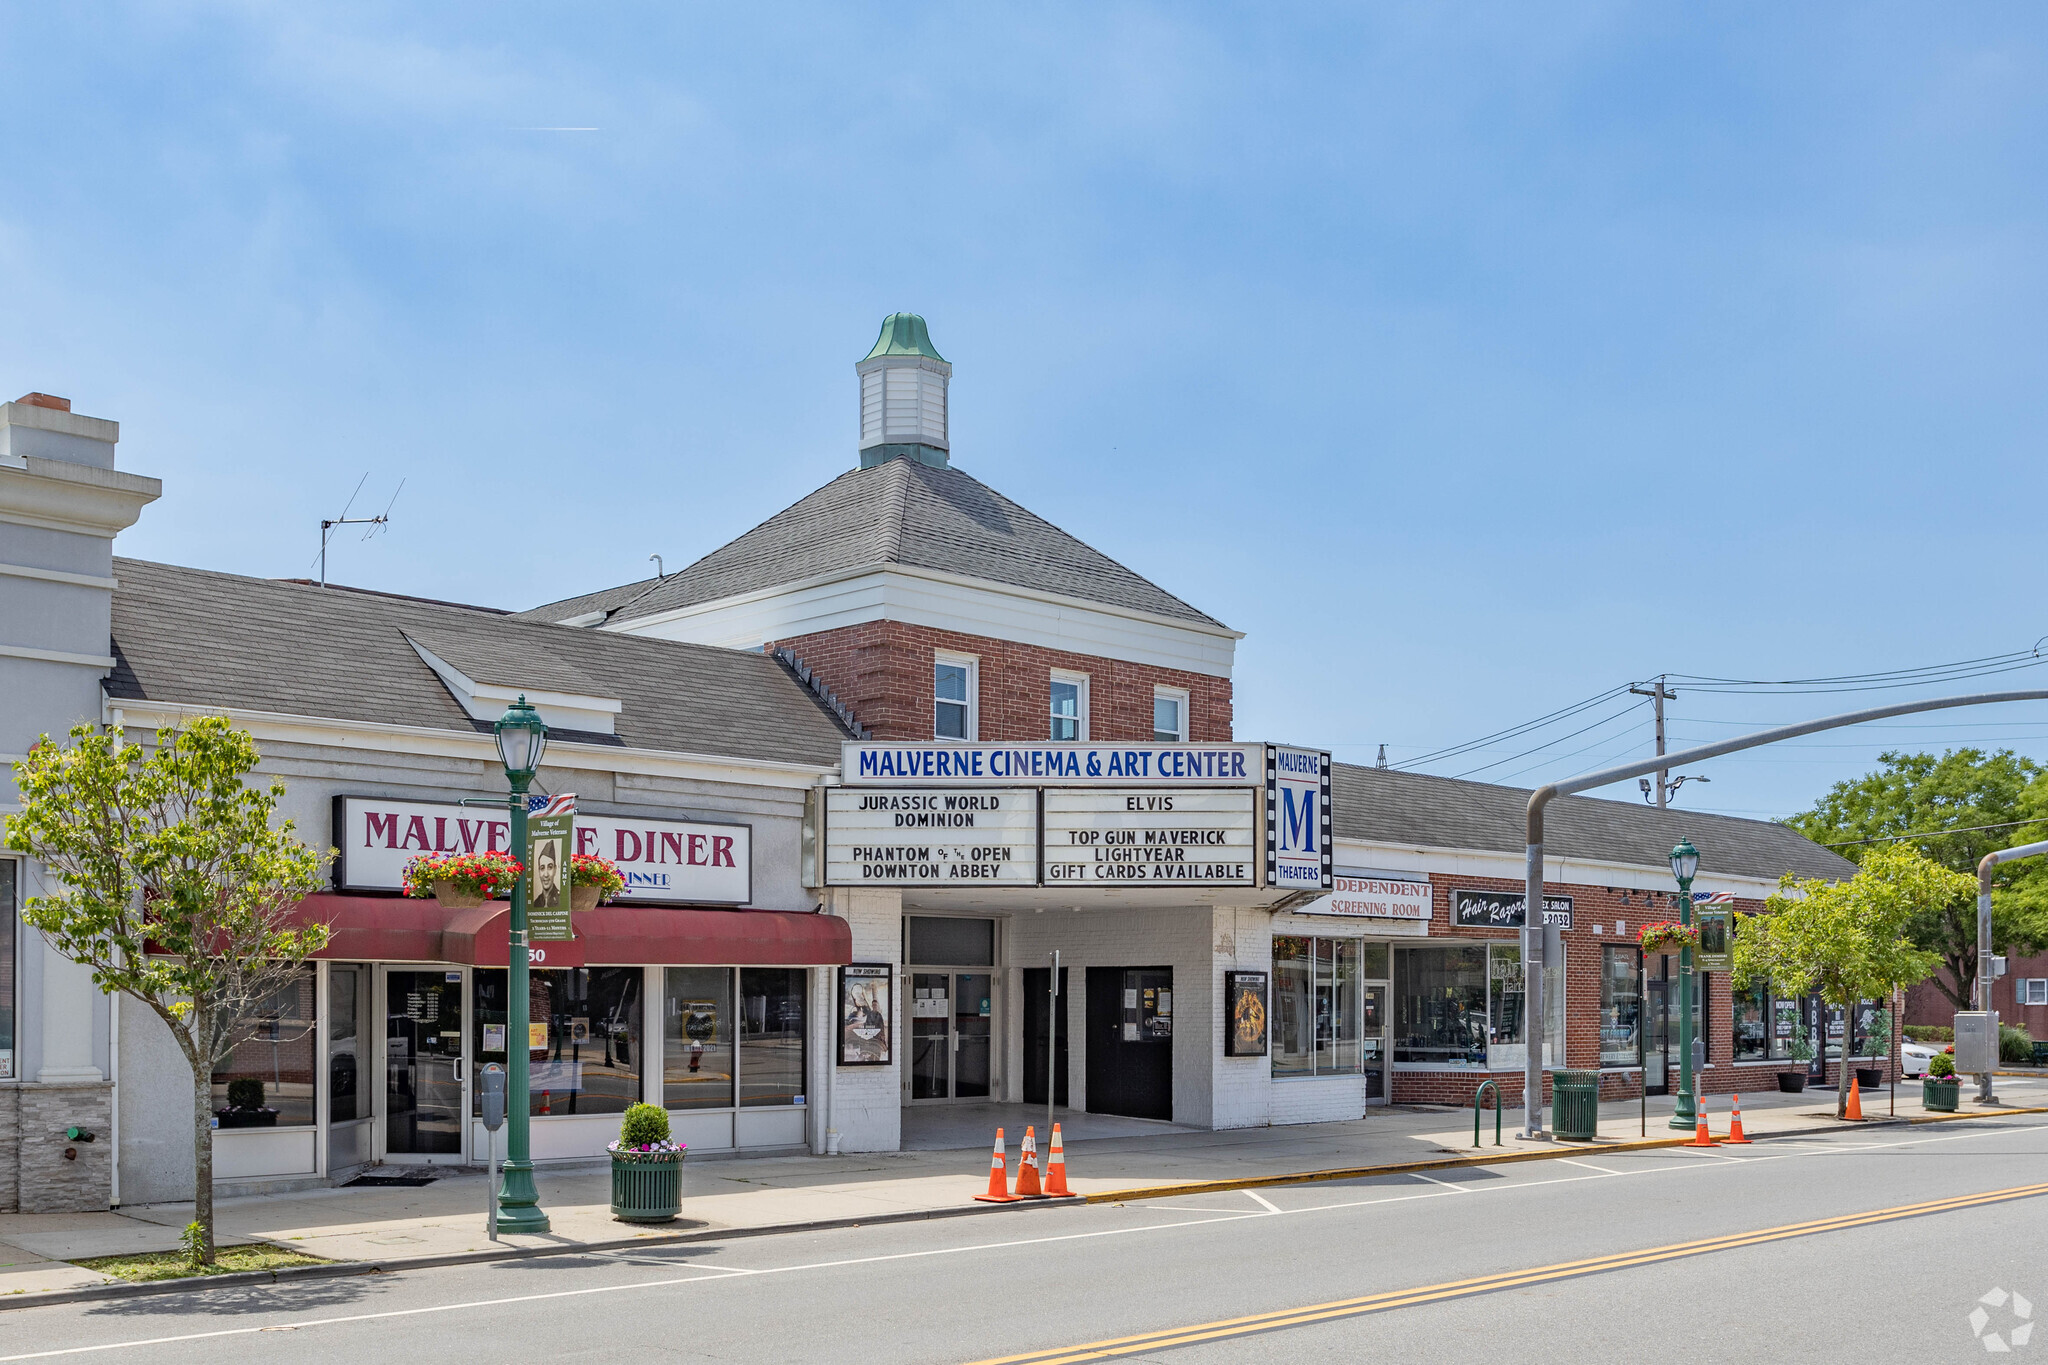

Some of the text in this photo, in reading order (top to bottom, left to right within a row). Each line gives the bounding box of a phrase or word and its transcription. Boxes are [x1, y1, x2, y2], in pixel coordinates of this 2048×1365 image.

[860, 751, 1247, 777] MALVERNE CINEMA & ART CENTER
[1278, 752, 1318, 774] MALVERNE
[859, 796, 1000, 810] JURASSIC WORLD
[1126, 797, 1173, 810] ELVIS
[895, 813, 974, 827] DOMINION
[1279, 786, 1317, 852] M
[1069, 831, 1225, 844] TOP GUN MAVERICK
[615, 829, 736, 867] DINER
[853, 847, 1011, 861] PHANTOM OF THE OPEN
[1095, 848, 1185, 862] LIGHTYEAR
[863, 864, 1000, 878] DOWNTON ABBEY
[1050, 864, 1244, 878] GIFT CARDS AVAILABLE
[1279, 865, 1318, 880] THEATERS
[625, 871, 671, 886] INNER
[1334, 878, 1430, 897] DEPENDENT
[1331, 899, 1420, 916] SCREENING ROOM
[1460, 898, 1487, 919] Hair
[1551, 901, 1569, 910] SALON
